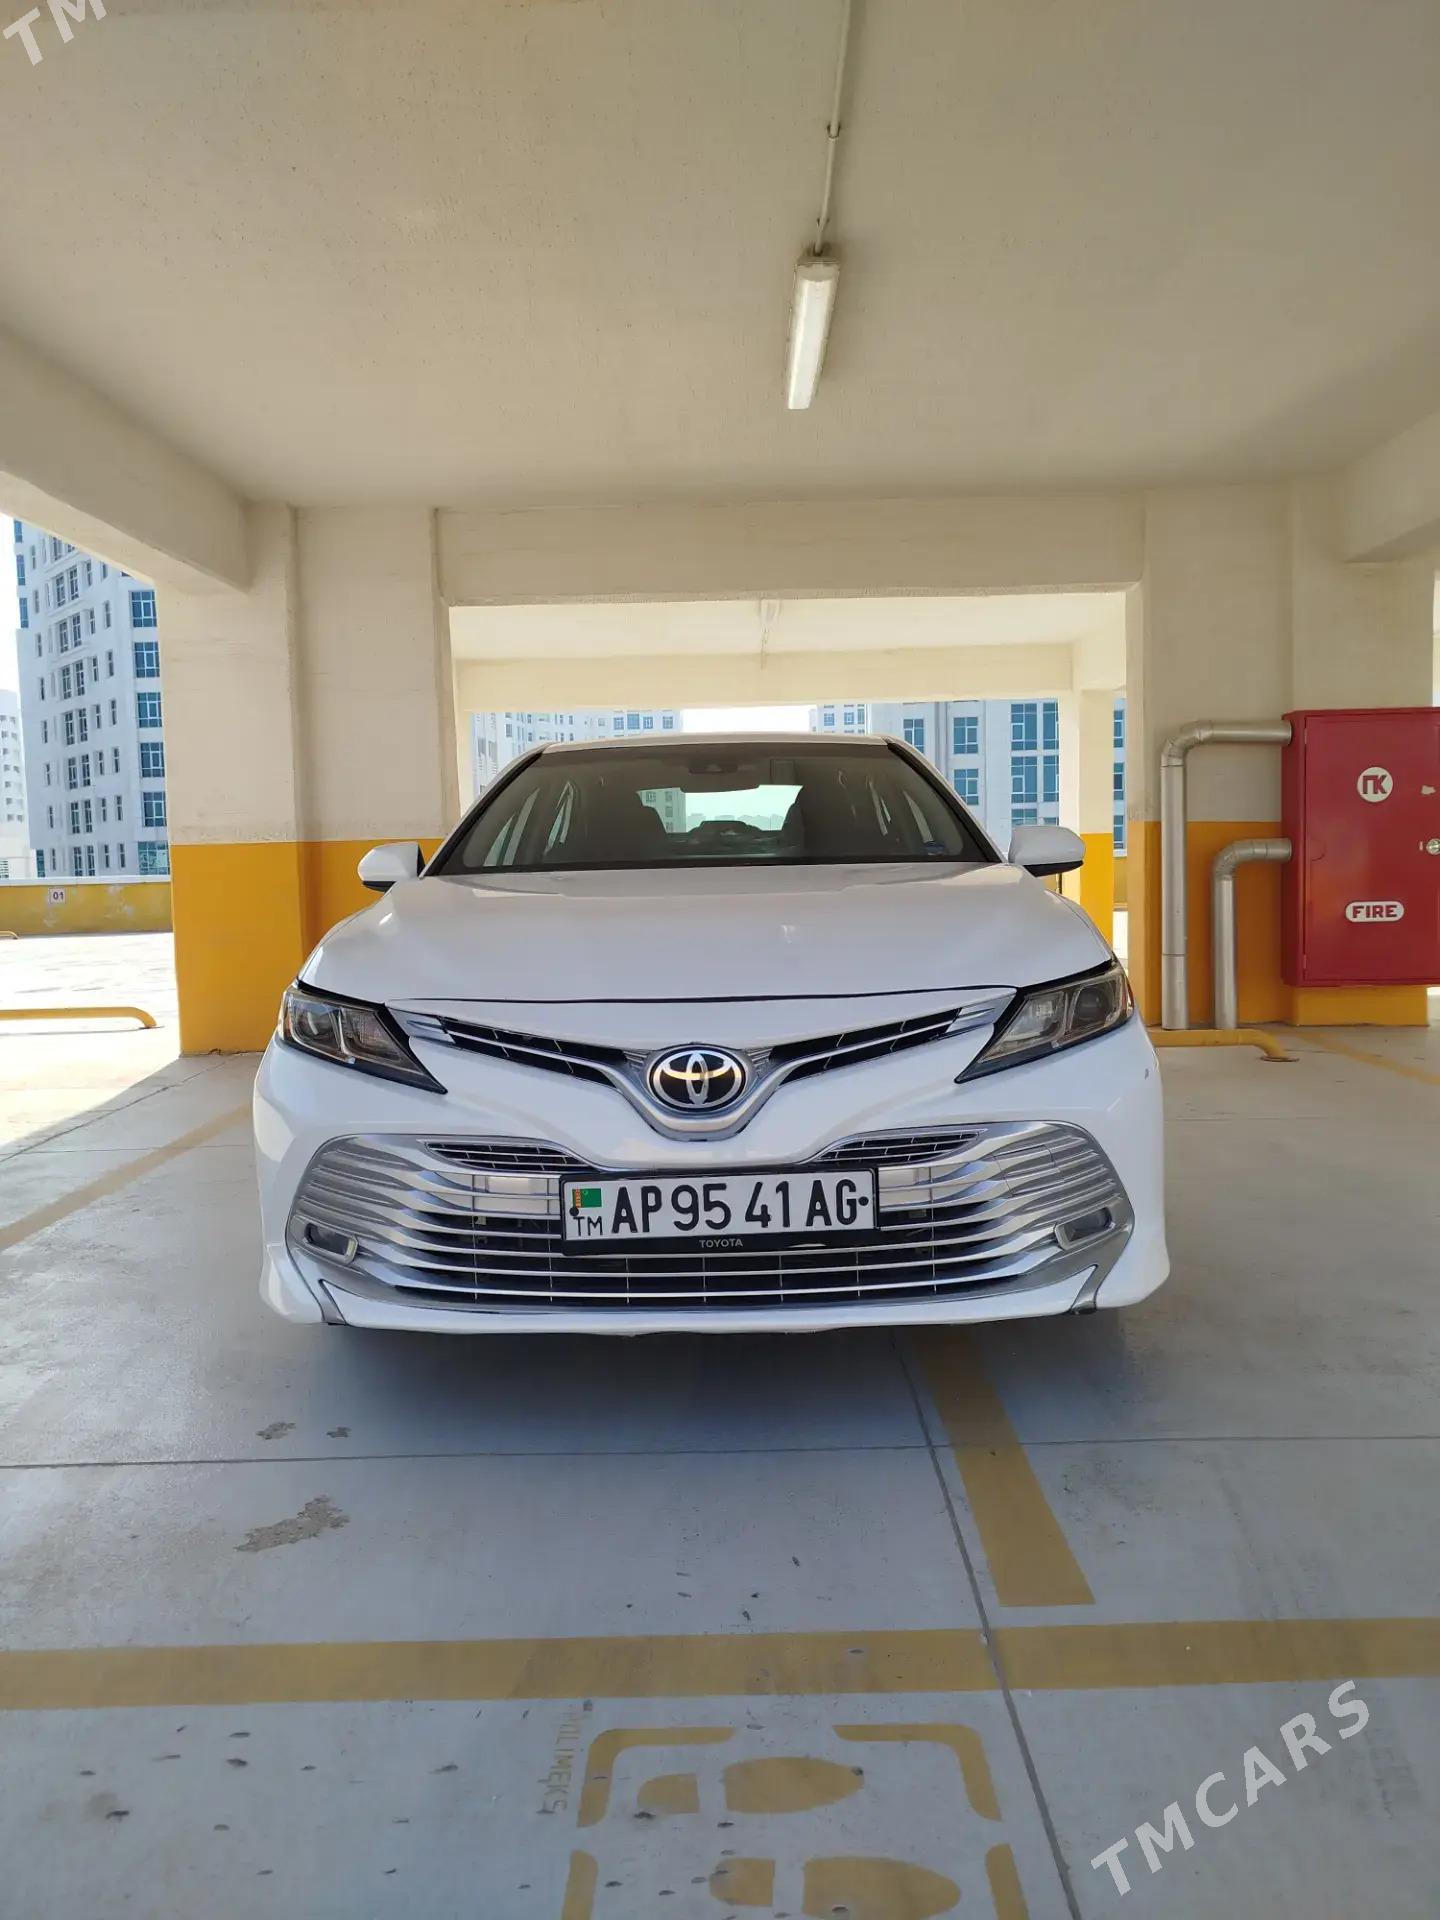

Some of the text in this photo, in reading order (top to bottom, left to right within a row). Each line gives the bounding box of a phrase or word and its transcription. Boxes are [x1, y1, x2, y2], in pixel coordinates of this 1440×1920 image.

[53, 891, 64, 900] 01
[1352, 904, 1398, 919] FIRE
[573, 1215, 603, 1237] TM
[699, 1237, 744, 1249] TOYOTA
